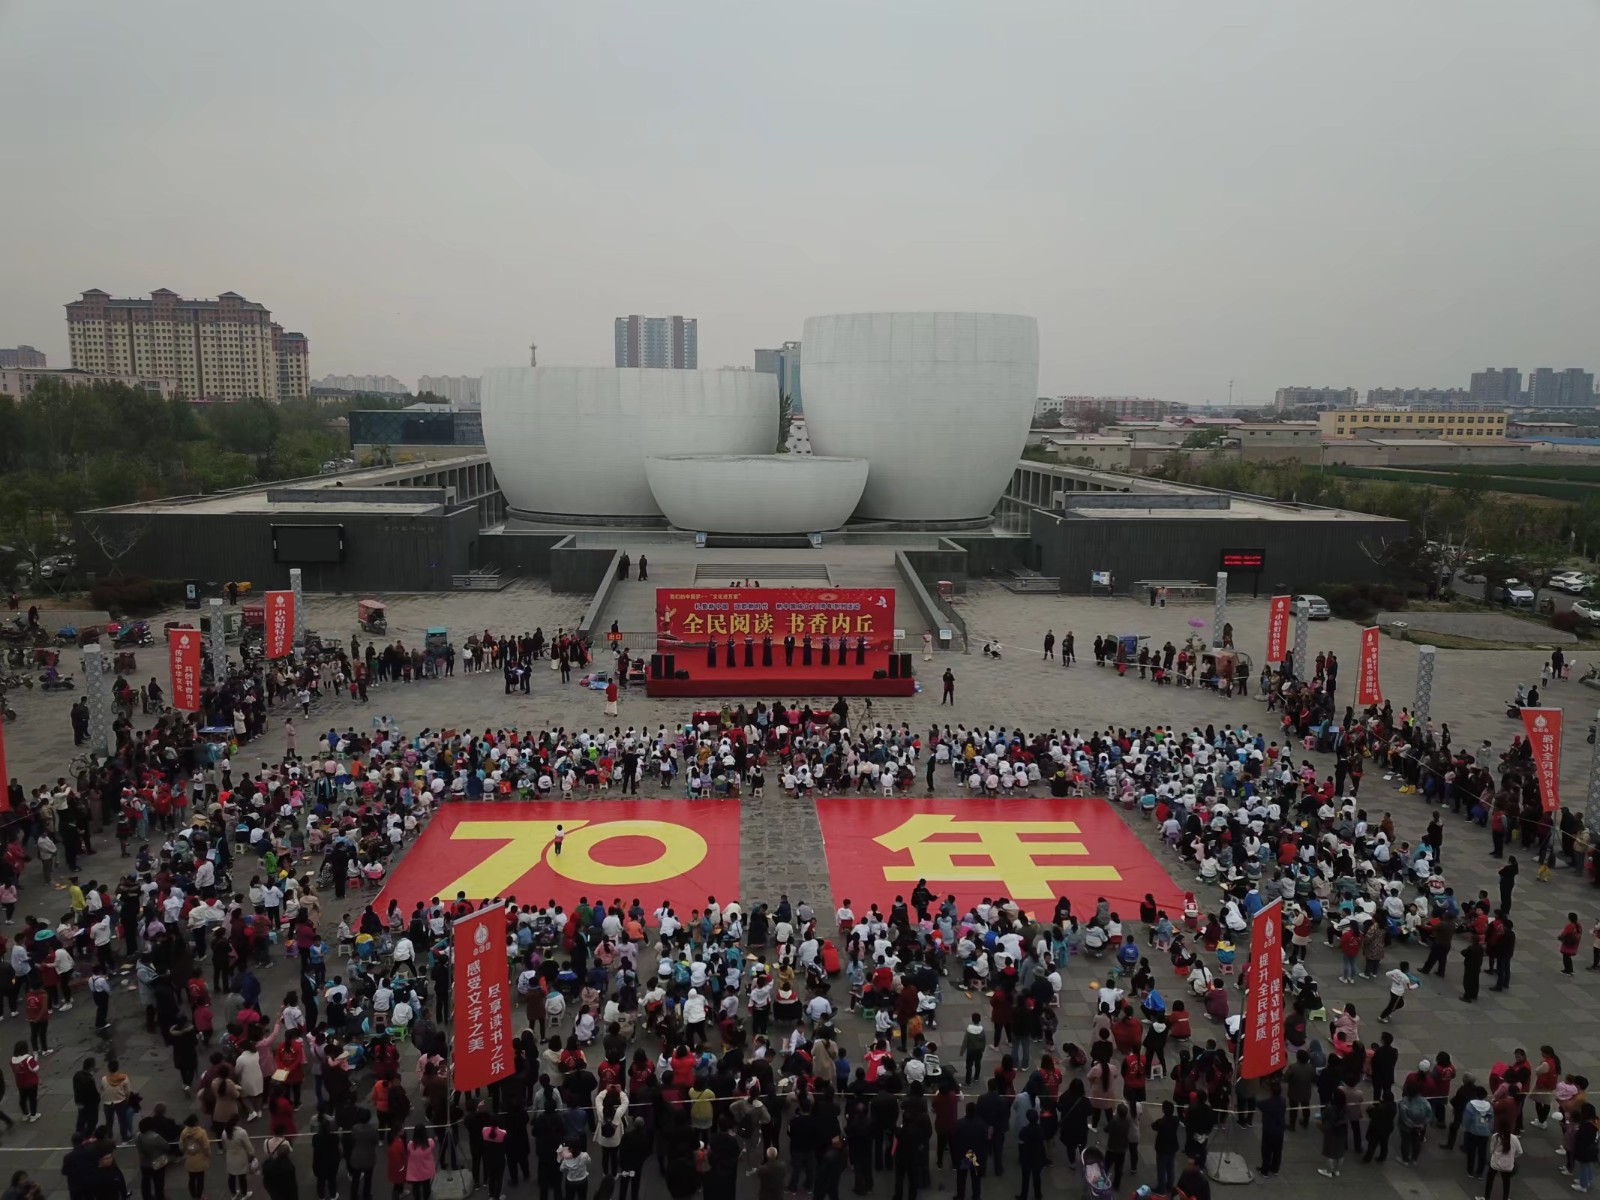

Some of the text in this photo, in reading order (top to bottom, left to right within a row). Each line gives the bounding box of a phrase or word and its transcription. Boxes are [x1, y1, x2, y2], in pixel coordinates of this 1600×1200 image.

[683, 612, 874, 634] 全民阅读 书香内丘
[429, 814, 1123, 900] 70 年
[467, 959, 485, 1054] 感受文字之美
[488, 983, 505, 1076] 尽享读书之乐
[1255, 952, 1269, 1042] 提升全民素质
